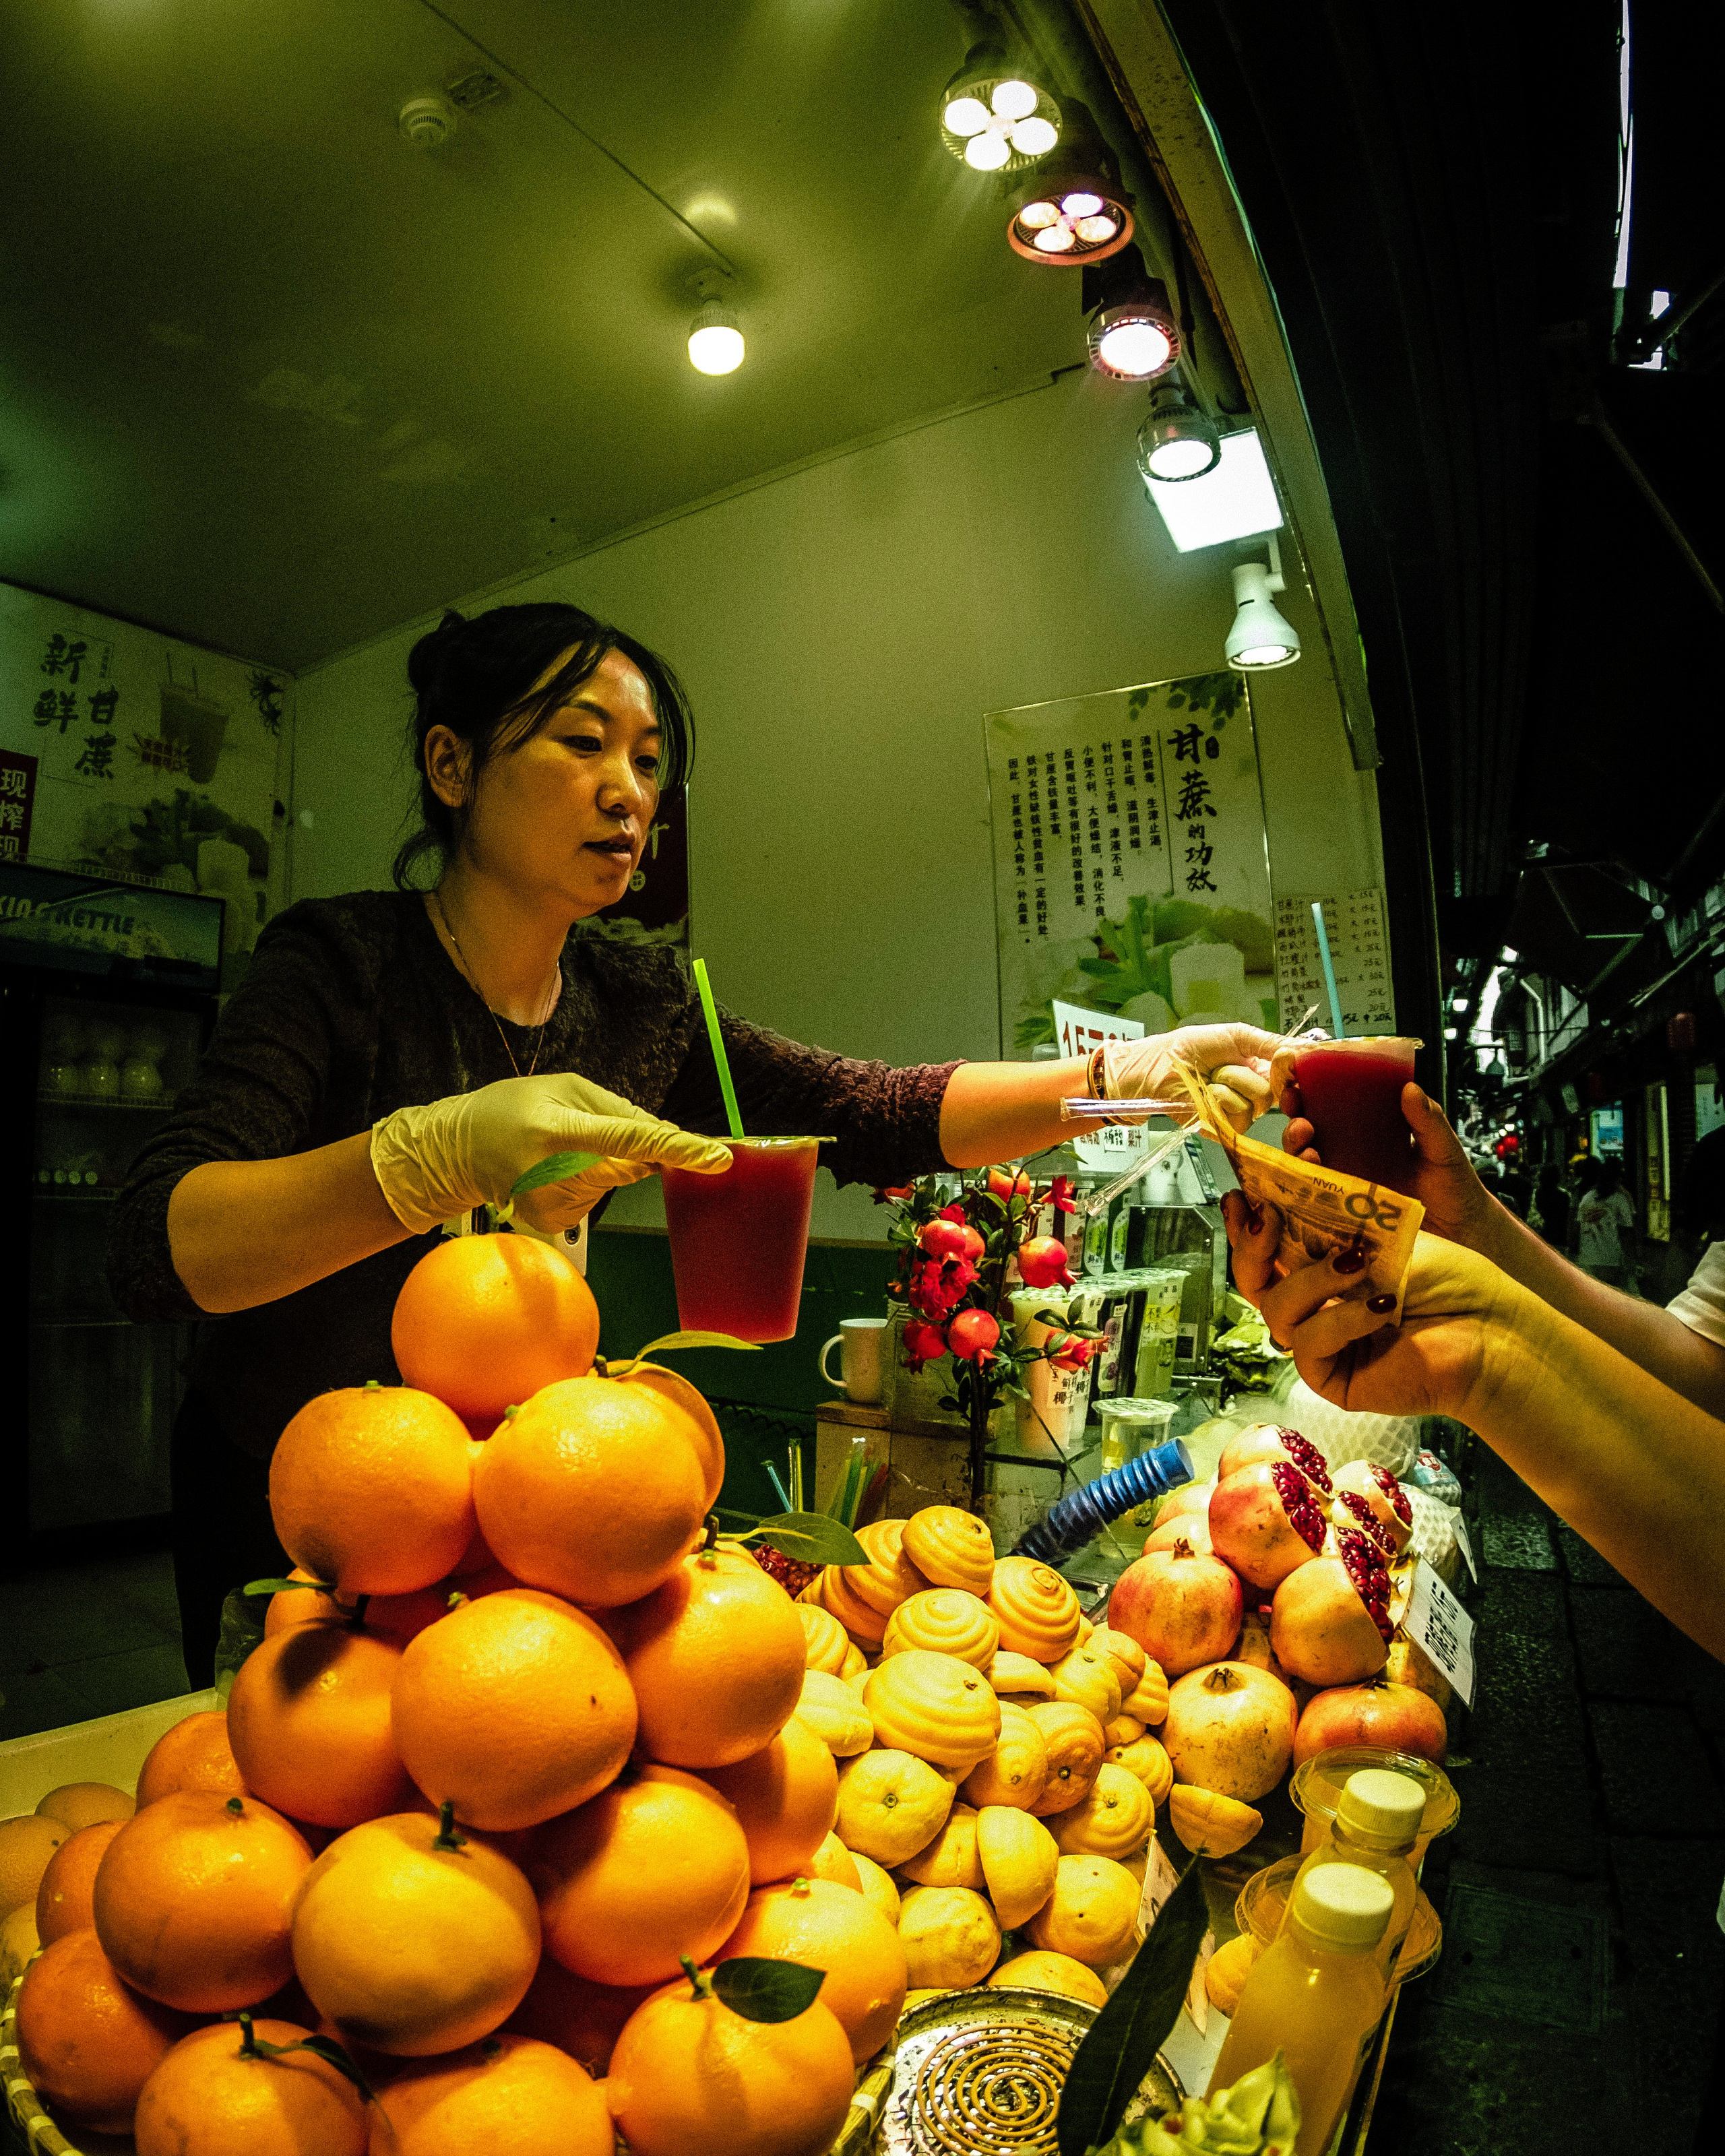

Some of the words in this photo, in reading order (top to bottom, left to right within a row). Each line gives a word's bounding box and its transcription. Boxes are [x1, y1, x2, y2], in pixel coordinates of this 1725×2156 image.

[34, 633, 88, 734] 新鲜
[74, 684, 120, 780] 甘蔗
[1166, 722, 1218, 892] 甘蔗的功效
[1313, 1177, 1345, 1195] YUAN
[1344, 1192, 1403, 1232] 20
